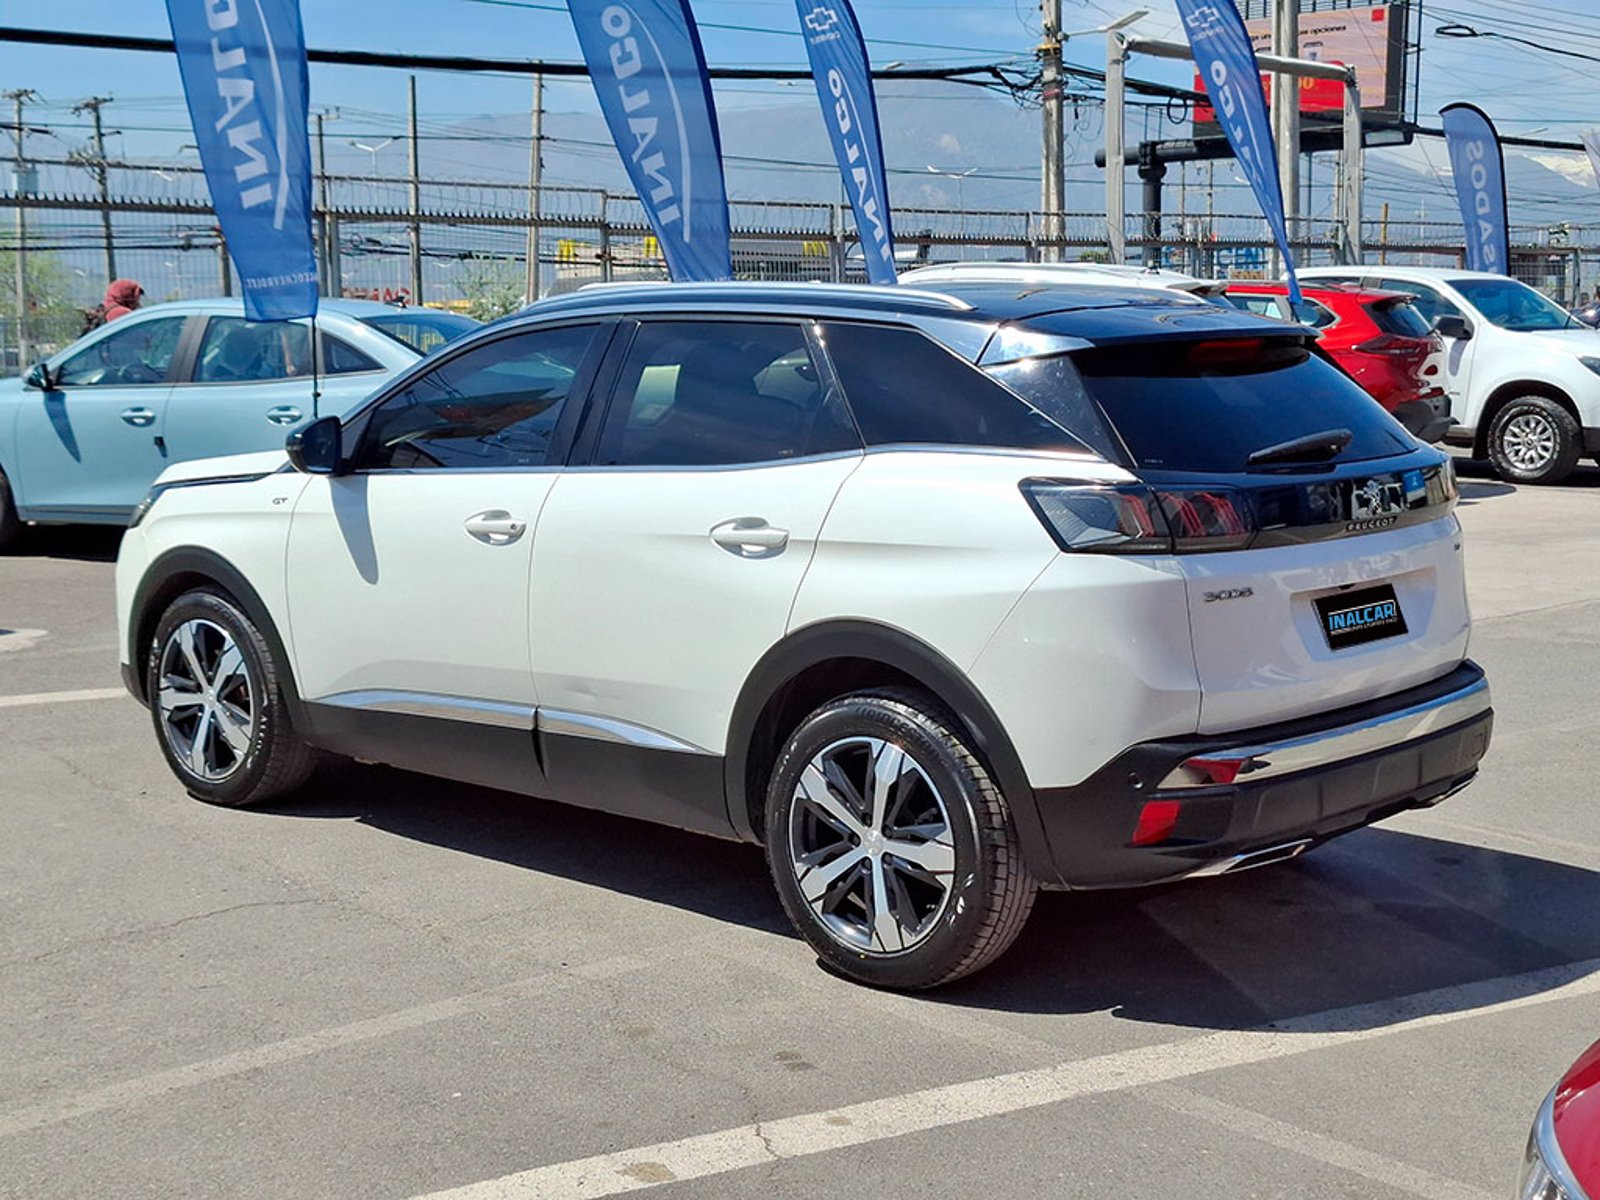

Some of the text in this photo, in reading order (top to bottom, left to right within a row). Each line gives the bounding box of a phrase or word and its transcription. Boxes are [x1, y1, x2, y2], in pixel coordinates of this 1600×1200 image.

[272, 497, 288, 505] GT
[1346, 516, 1397, 531] PEUGEOT
[1328, 603, 1394, 630] INALCAR
